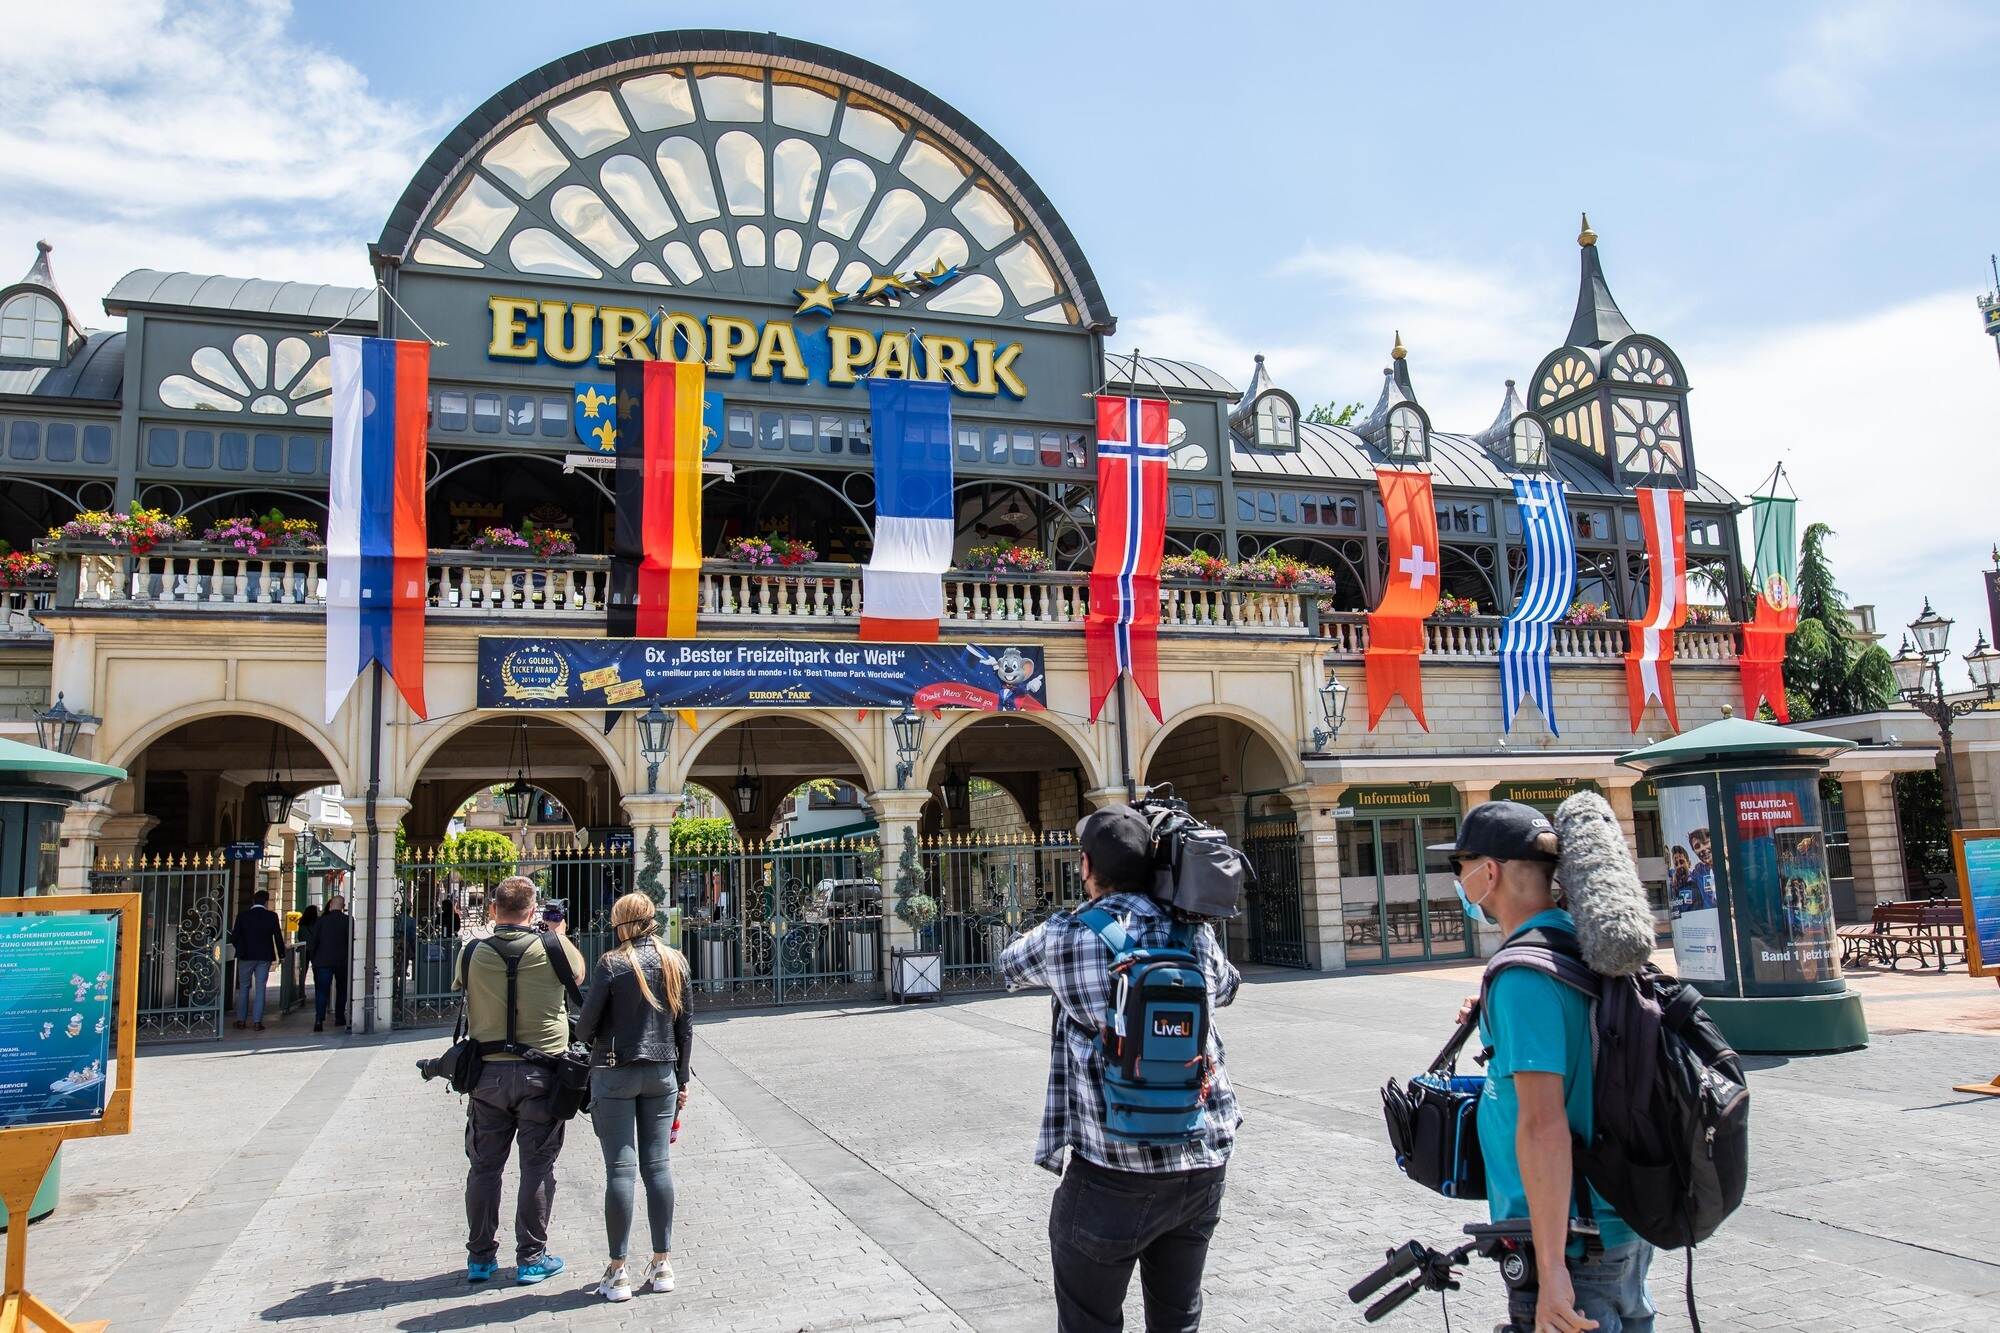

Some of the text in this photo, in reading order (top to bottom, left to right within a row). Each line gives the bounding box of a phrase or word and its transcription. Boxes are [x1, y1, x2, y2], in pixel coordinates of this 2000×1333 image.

[488, 296, 1027, 399] EUROPA PARK
[528, 657, 554, 665] GOLDEN
[645, 647, 665, 663] 6x
[671, 647, 732, 666] „Bester
[737, 647, 830, 666] Freizeitpark
[834, 648, 860, 665] der
[512, 666, 558, 674] TICKET AWARD
[646, 669, 655, 677] 6x
[694, 670, 710, 678] parc
[712, 669, 721, 677] de
[723, 669, 745, 677] loisirs
[747, 669, 756, 677] du
[792, 669, 802, 677] 6x
[824, 669, 847, 678] Theme
[849, 670, 866, 678] Park
[749, 691, 811, 700] EUROPA PARK
[920, 691, 941, 702] Danke
[942, 688, 961, 698] Merci
[964, 690, 983, 703] Thank
[1358, 791, 1430, 805] Information
[1510, 787, 1575, 800] Information
[1740, 800, 1787, 809] RULANTICA
[1742, 811, 1792, 821] DER ROMAN
[12, 930, 93, 939] SICHERHEITSVORGABEN
[54, 938, 105, 946] ATTRAKTIONEN
[1761, 950, 1790, 961] Band
[1793, 951, 1799, 960] 1
[1803, 949, 1822, 962] jetzt
[1154, 1018, 1190, 1036] LiveU
